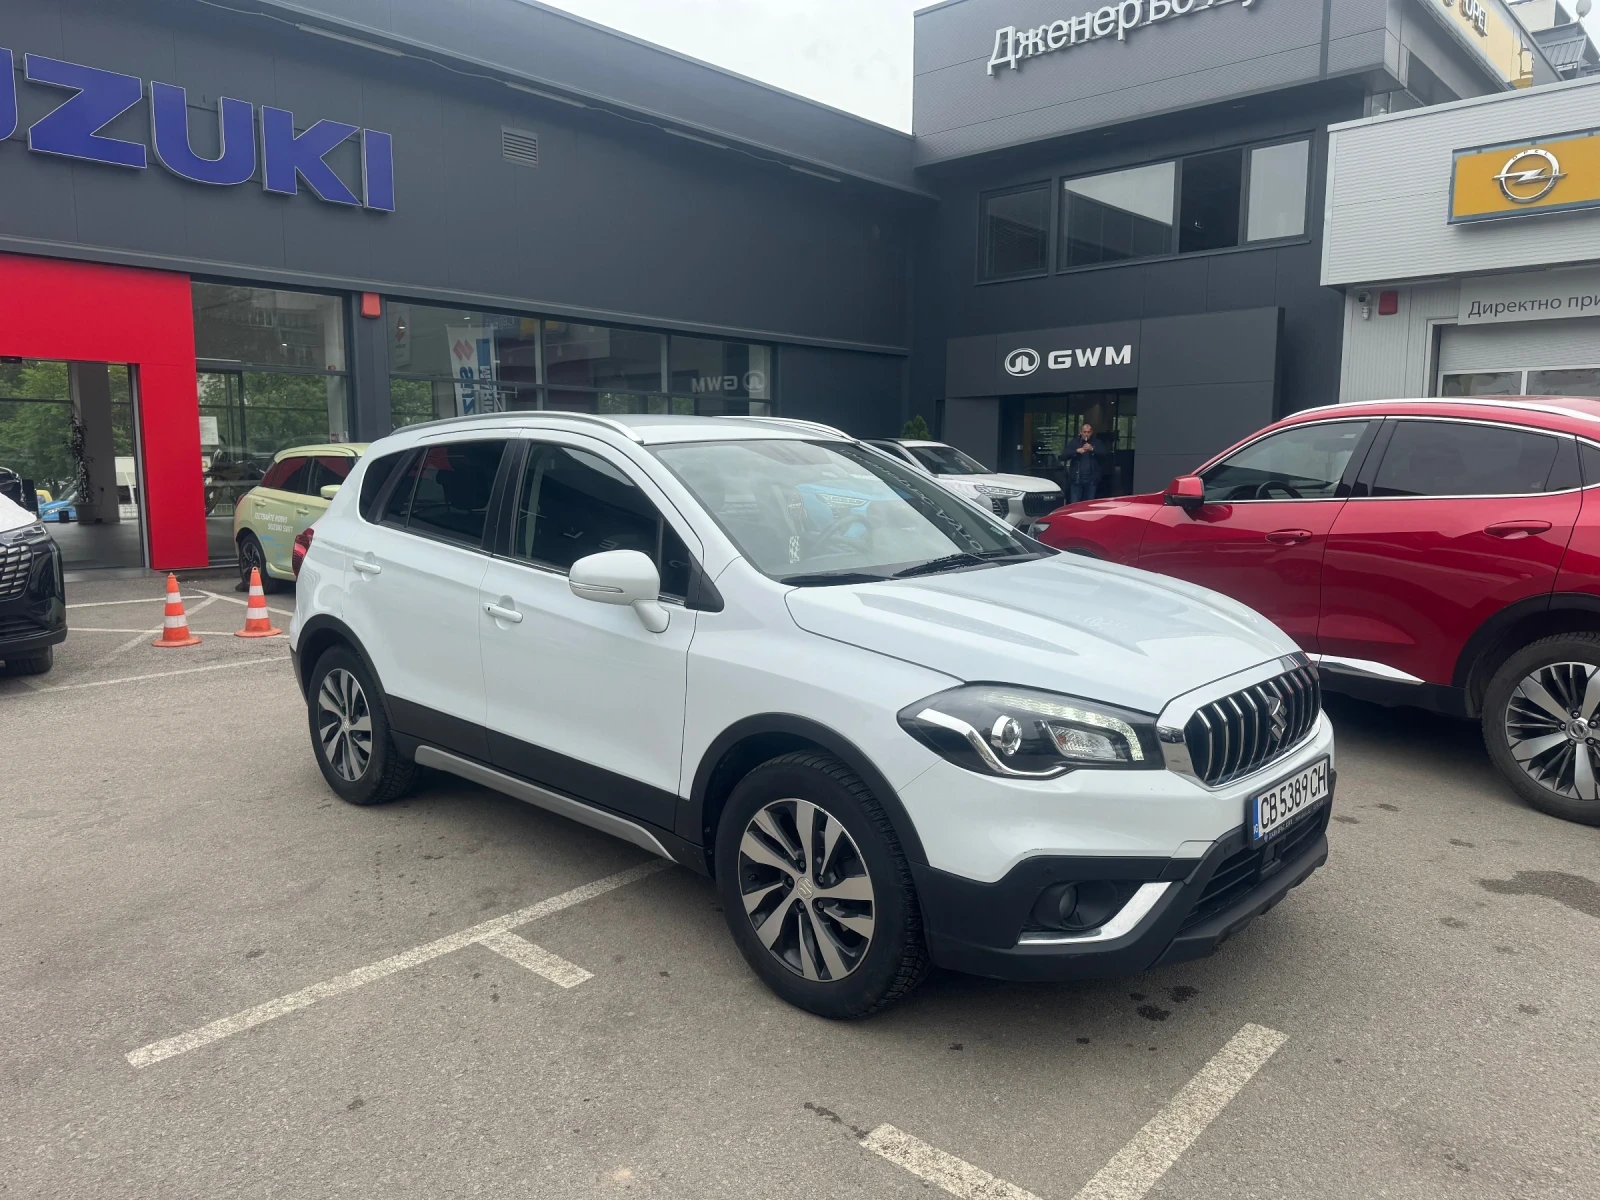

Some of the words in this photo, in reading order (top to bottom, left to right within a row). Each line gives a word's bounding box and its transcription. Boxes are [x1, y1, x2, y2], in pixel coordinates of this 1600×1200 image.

[1512, 149, 1548, 160] OPEL
[1467, 297, 1562, 318] Директно
[1047, 345, 1132, 369] GWM
[1261, 792, 1278, 829] CB
[1280, 774, 1308, 818] 5389
[1310, 763, 1326, 798] CH
